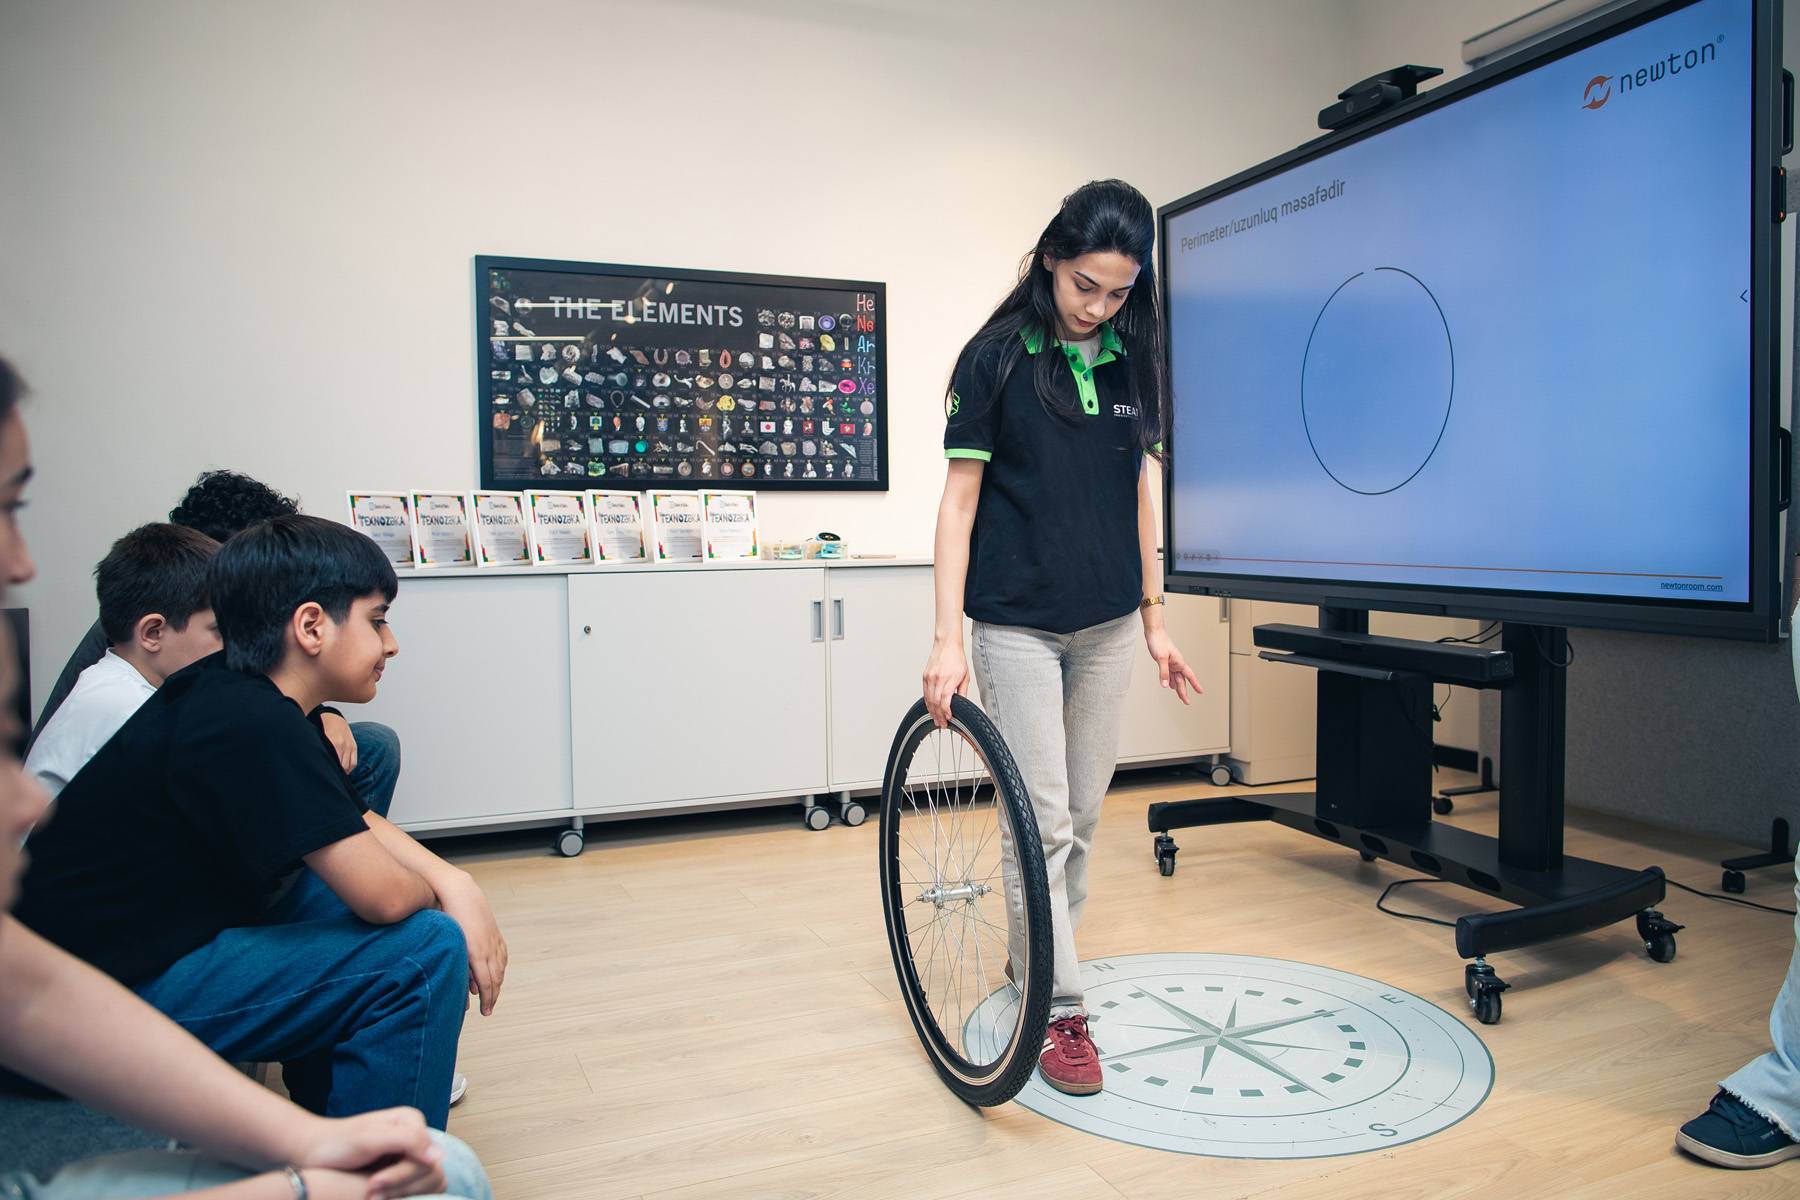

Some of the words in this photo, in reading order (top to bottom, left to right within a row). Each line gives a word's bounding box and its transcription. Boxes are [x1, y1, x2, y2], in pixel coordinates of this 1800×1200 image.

[1181, 206, 1278, 253] Perimeter/uzunluq
[1281, 179, 1346, 217] məsafədir
[549, 296, 602, 320] THE
[612, 299, 744, 327] ELEMENTS
[856, 293, 875, 312] He
[857, 335, 876, 353] Ar
[857, 356, 876, 375] Kr
[858, 377, 875, 395] Xe
[1113, 404, 1139, 417] STEA
[1660, 582, 1724, 592] newtonroom.com
[1368, 1122, 1399, 1138] S
